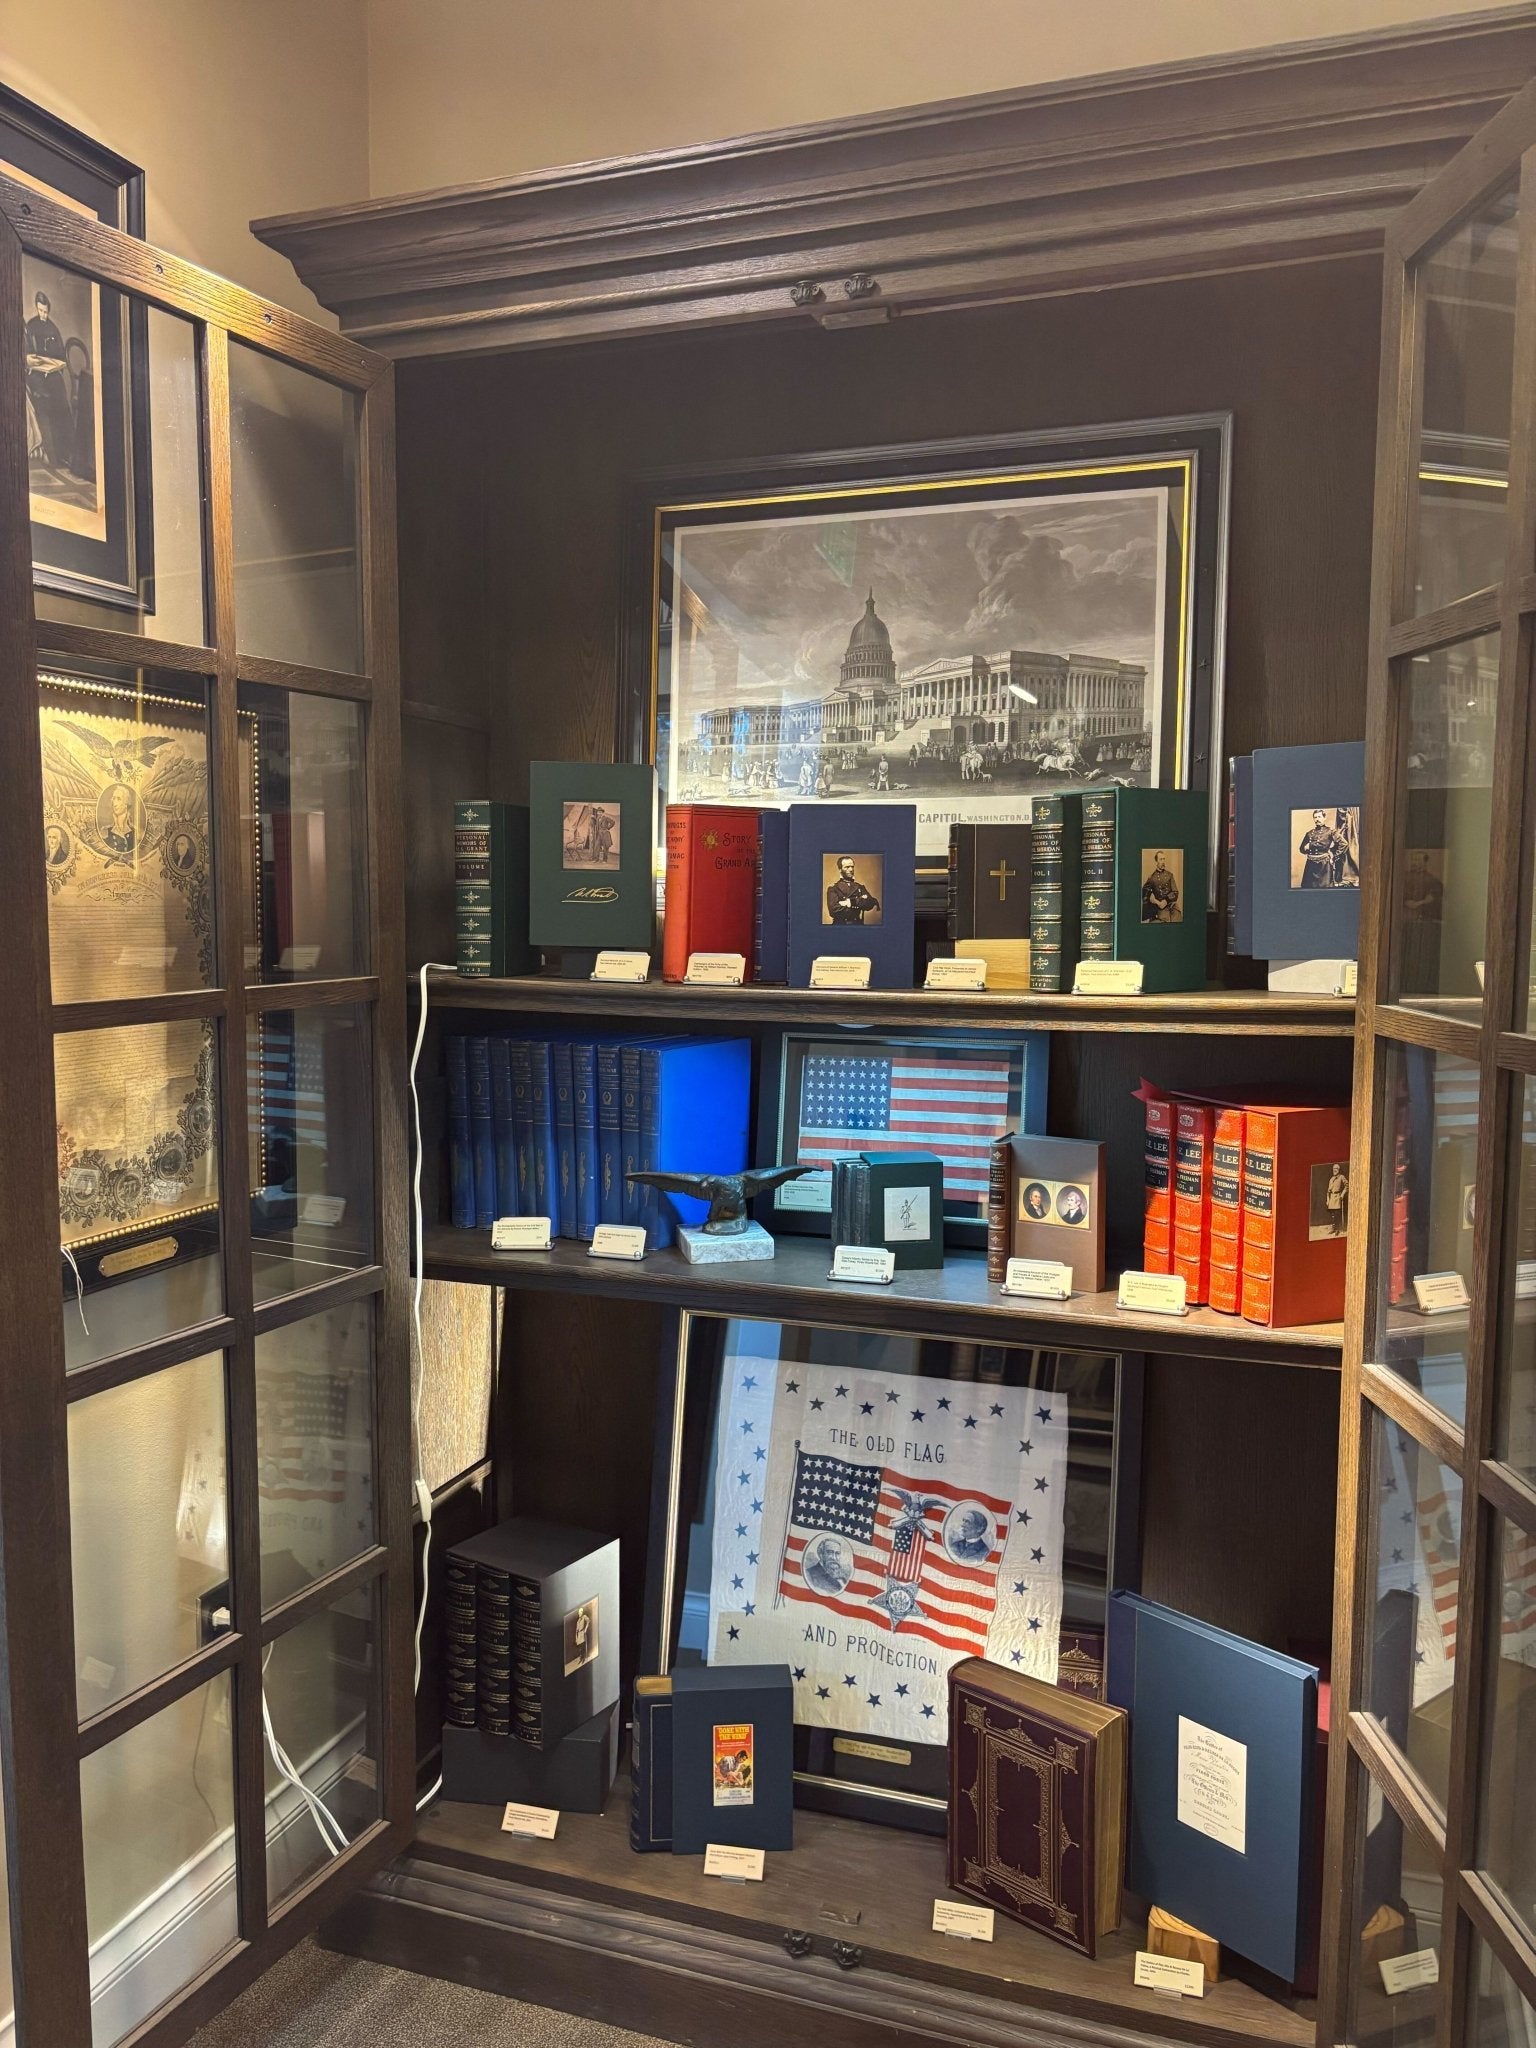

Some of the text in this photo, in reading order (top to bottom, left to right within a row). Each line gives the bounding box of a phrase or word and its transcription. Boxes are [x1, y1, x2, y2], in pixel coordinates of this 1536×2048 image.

[1153, 1142, 1168, 1152] LEE
[1185, 1149, 1202, 1159] LEE
[1222, 1154, 1239, 1165] LEE
[1256, 1161, 1272, 1172] LEE
[829, 1428, 945, 1464] THE OLD FLAG
[802, 1623, 837, 1648] AND
